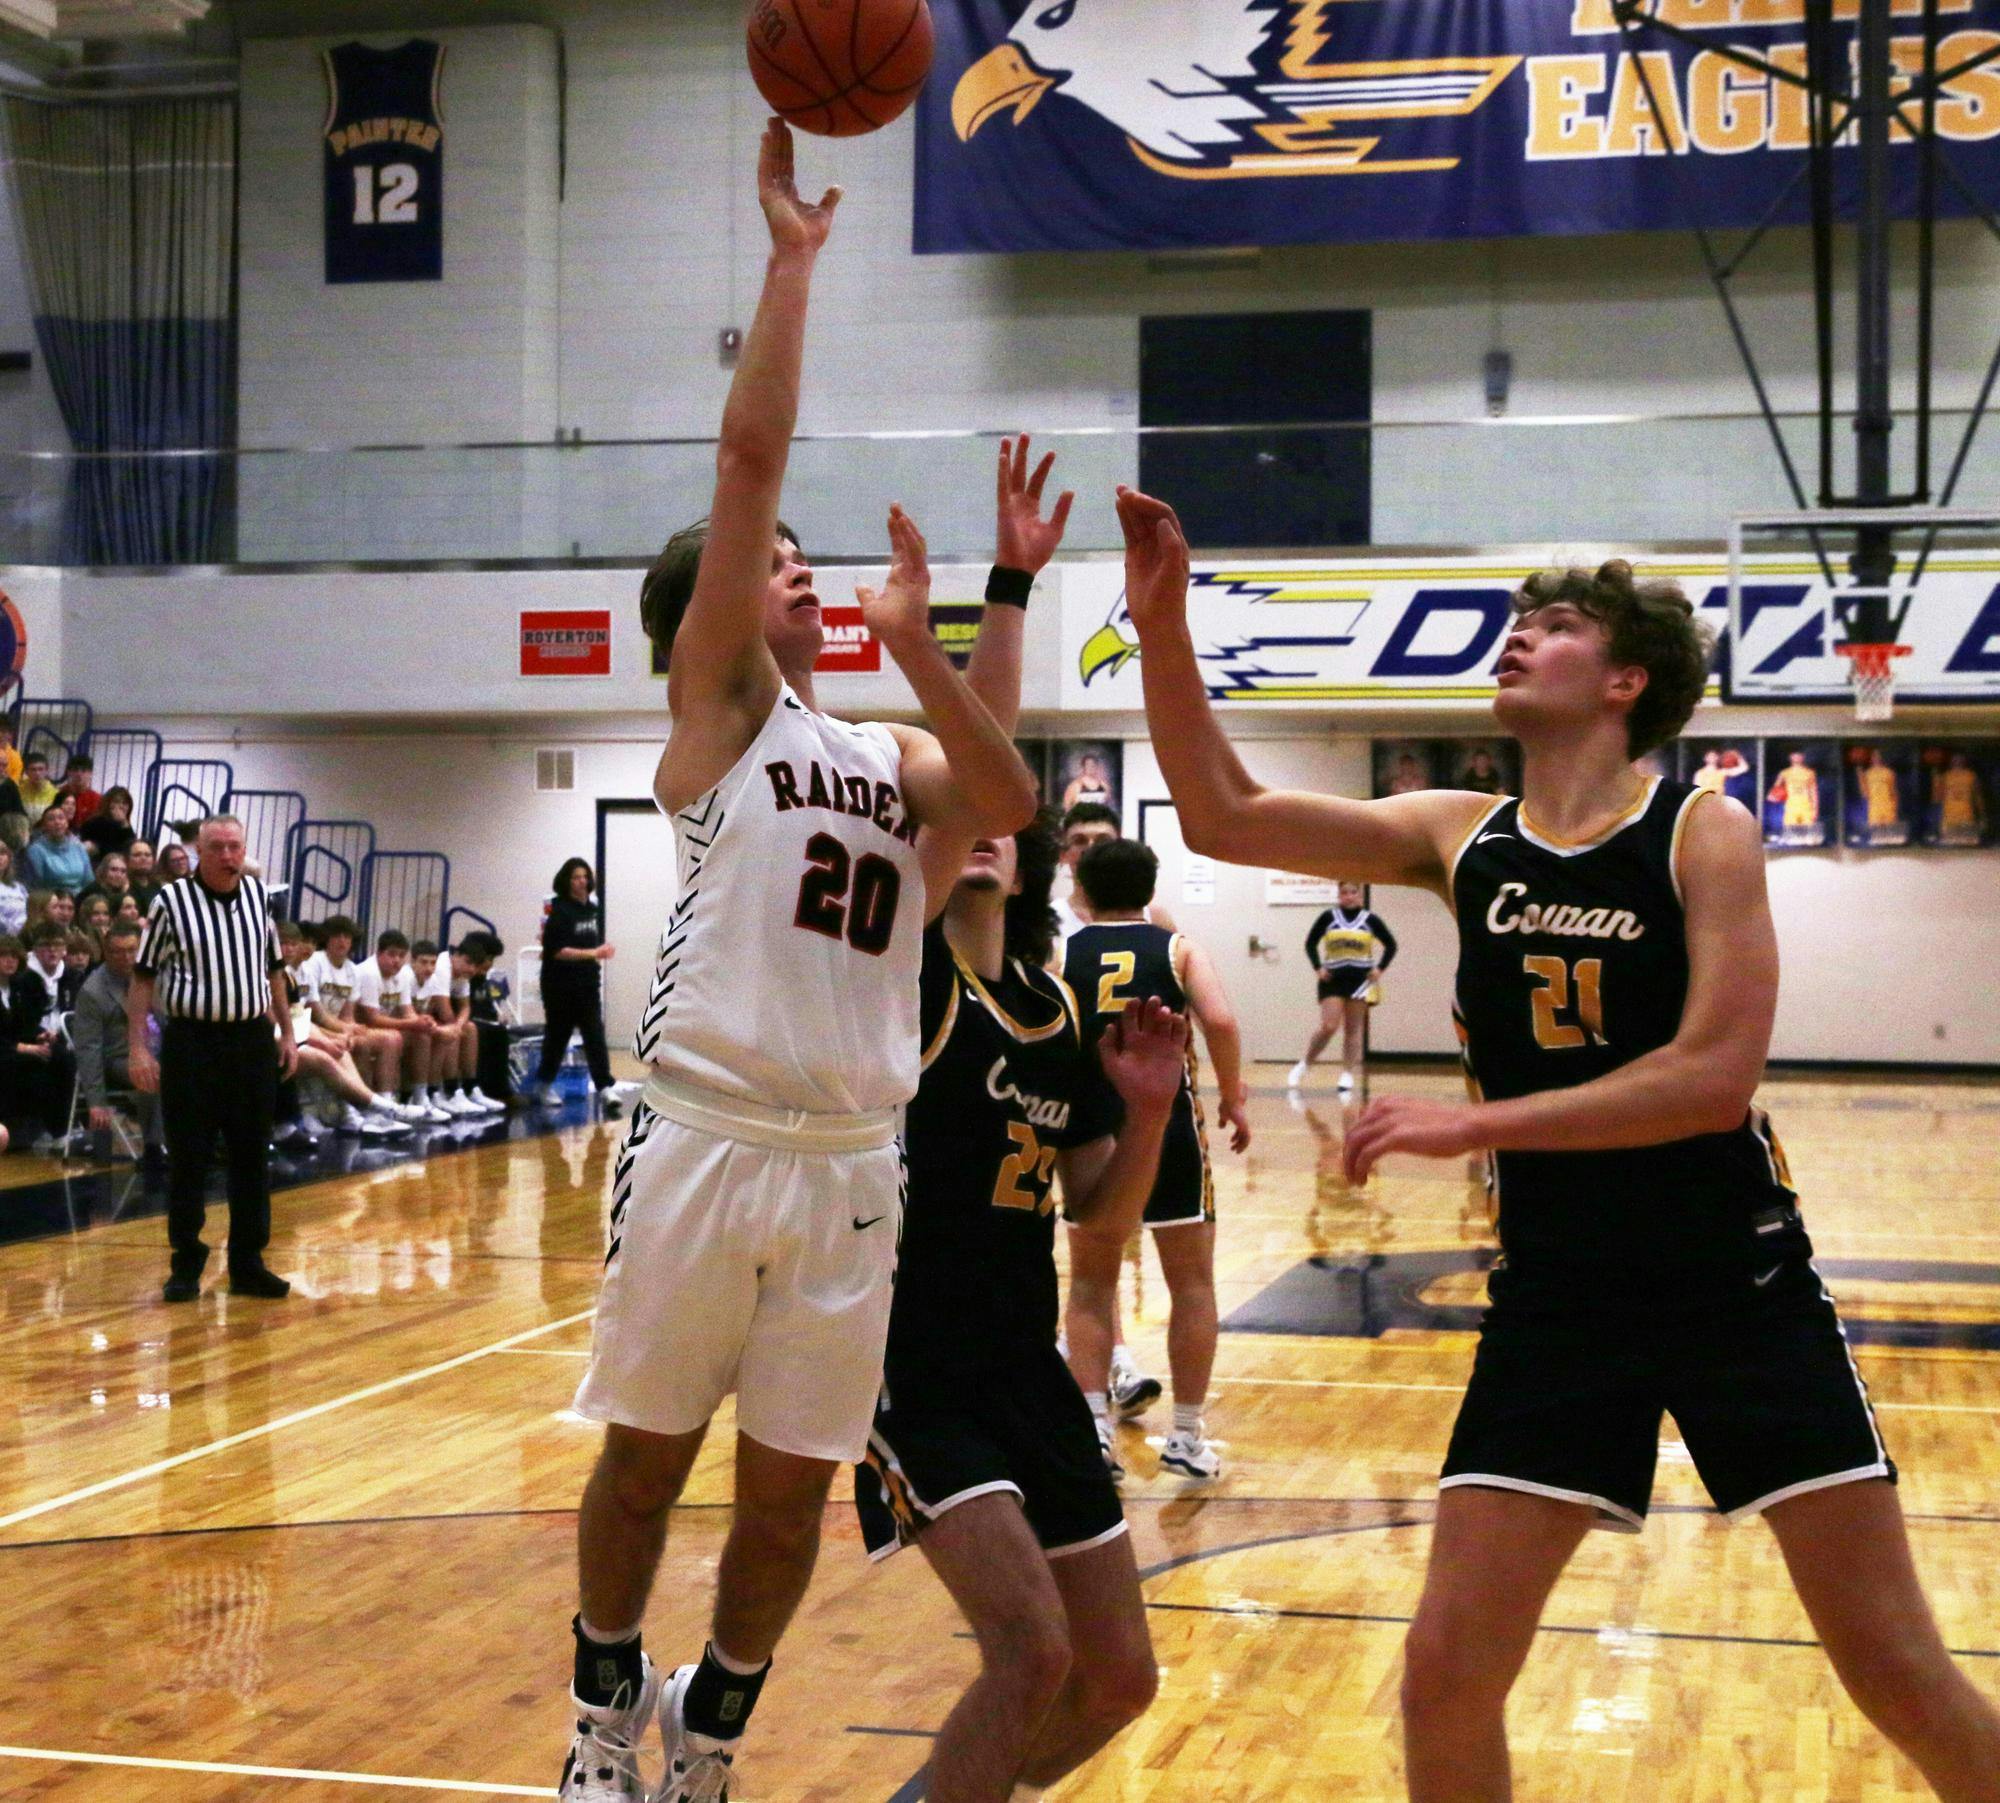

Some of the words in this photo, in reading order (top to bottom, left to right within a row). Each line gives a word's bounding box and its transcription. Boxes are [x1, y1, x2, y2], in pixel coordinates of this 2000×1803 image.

[1525, 29, 2000, 161] EAGLES
[352, 162, 419, 224] 12
[524, 630, 606, 644] ROYERTON
[793, 831, 900, 957] 20
[1486, 881, 1646, 942] Cowan
[1096, 950, 1137, 1014] 2
[1523, 953, 1610, 1050] 21
